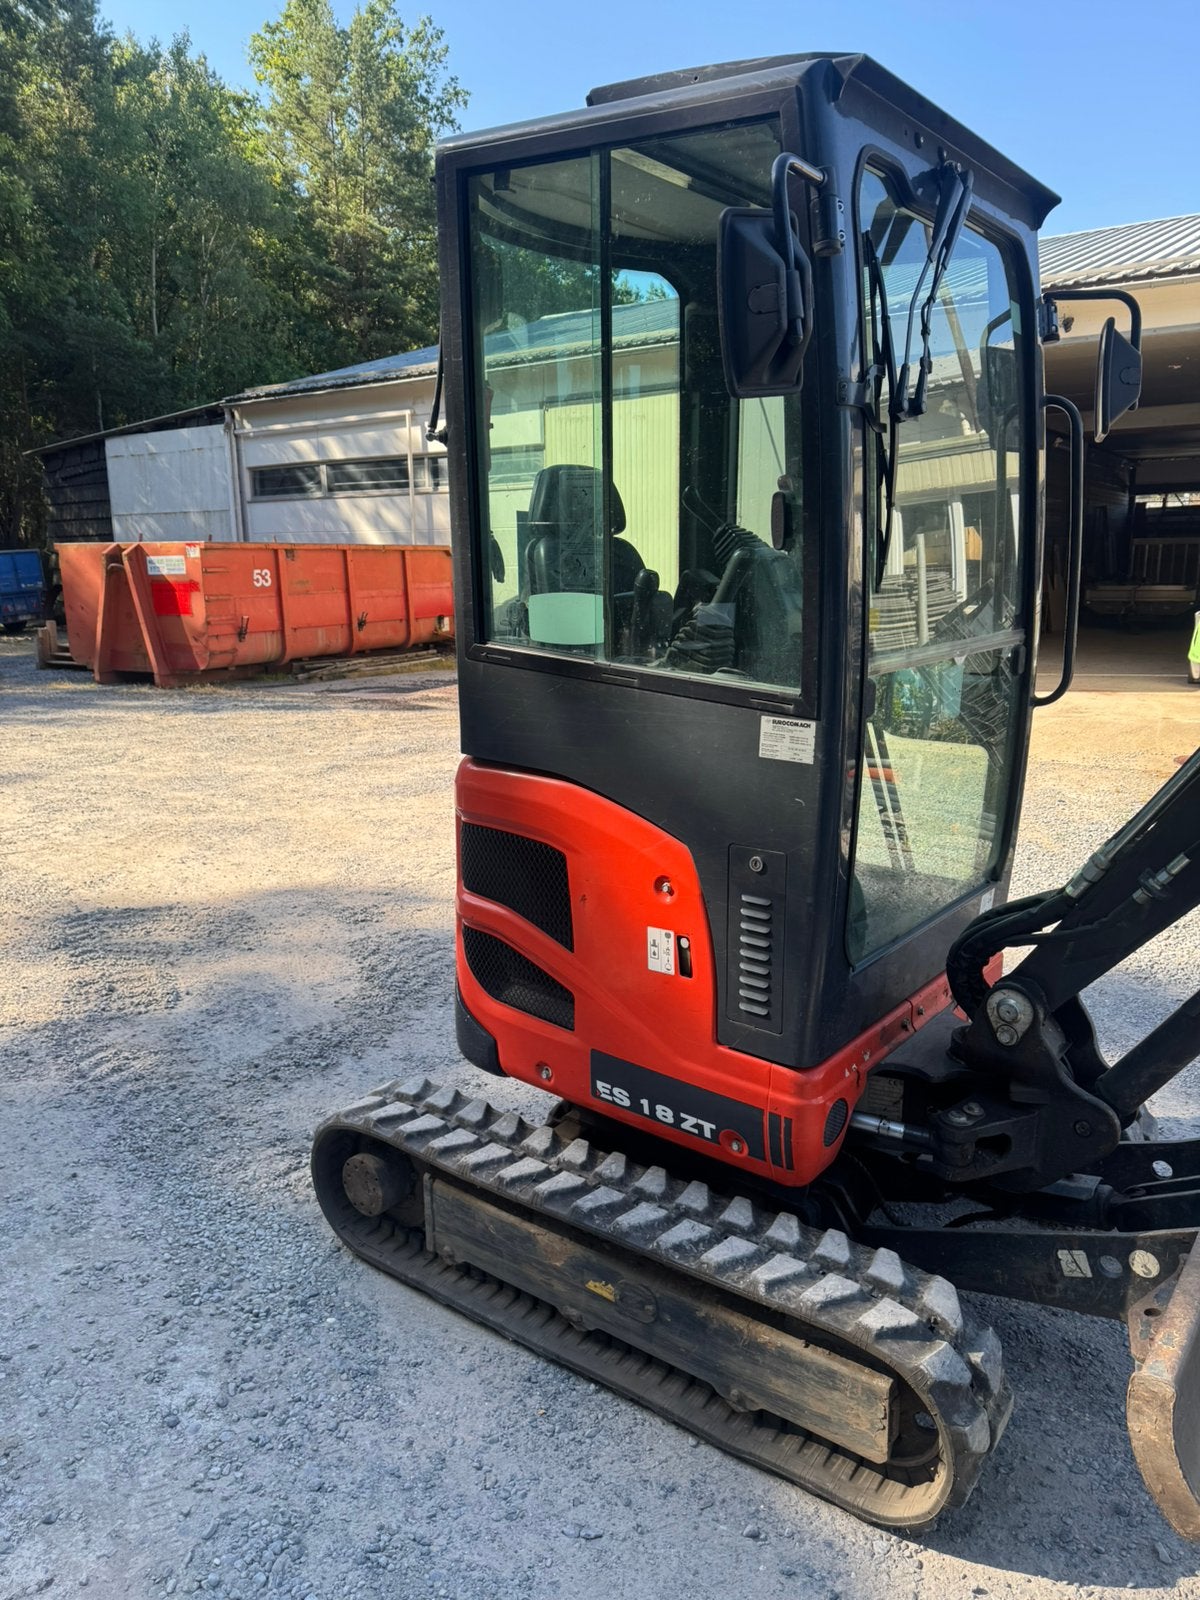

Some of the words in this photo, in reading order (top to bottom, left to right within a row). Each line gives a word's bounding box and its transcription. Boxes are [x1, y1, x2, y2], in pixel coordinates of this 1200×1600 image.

[252, 568, 272, 588] 53
[596, 1079, 631, 1107] ES
[680, 1112, 717, 1139] ZT
